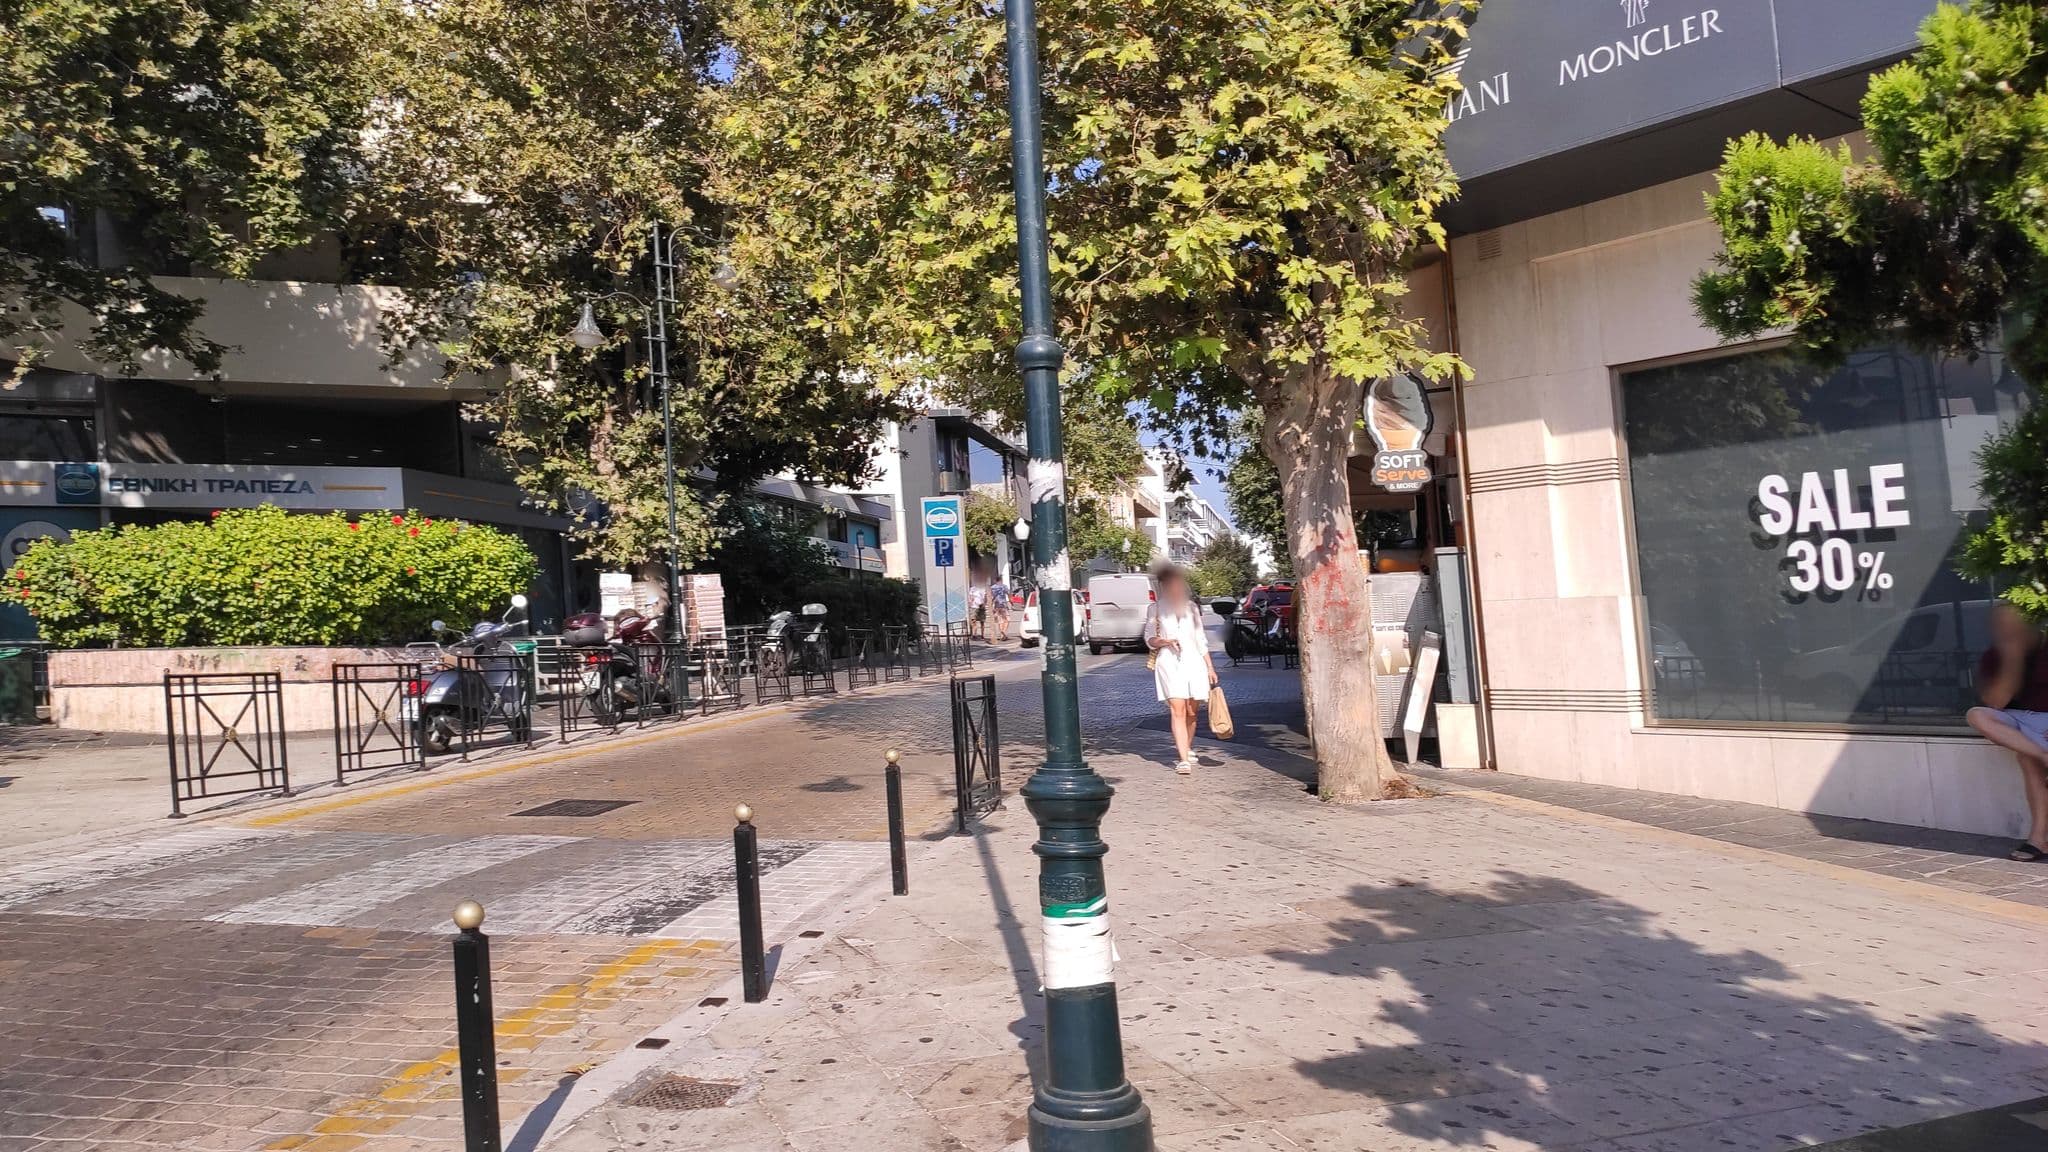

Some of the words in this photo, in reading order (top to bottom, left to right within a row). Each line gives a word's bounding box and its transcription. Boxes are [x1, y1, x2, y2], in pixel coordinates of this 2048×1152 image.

[1559, 9, 1724, 86] MONCLER
[1380, 454, 1423, 469] SOFT
[1376, 469, 1428, 482] Serve
[203, 479, 314, 494] ΤΡΑΠΕΖΑ
[1758, 463, 1910, 535] SALE
[939, 540, 949, 554] P
[1787, 538, 1893, 592] 30%
